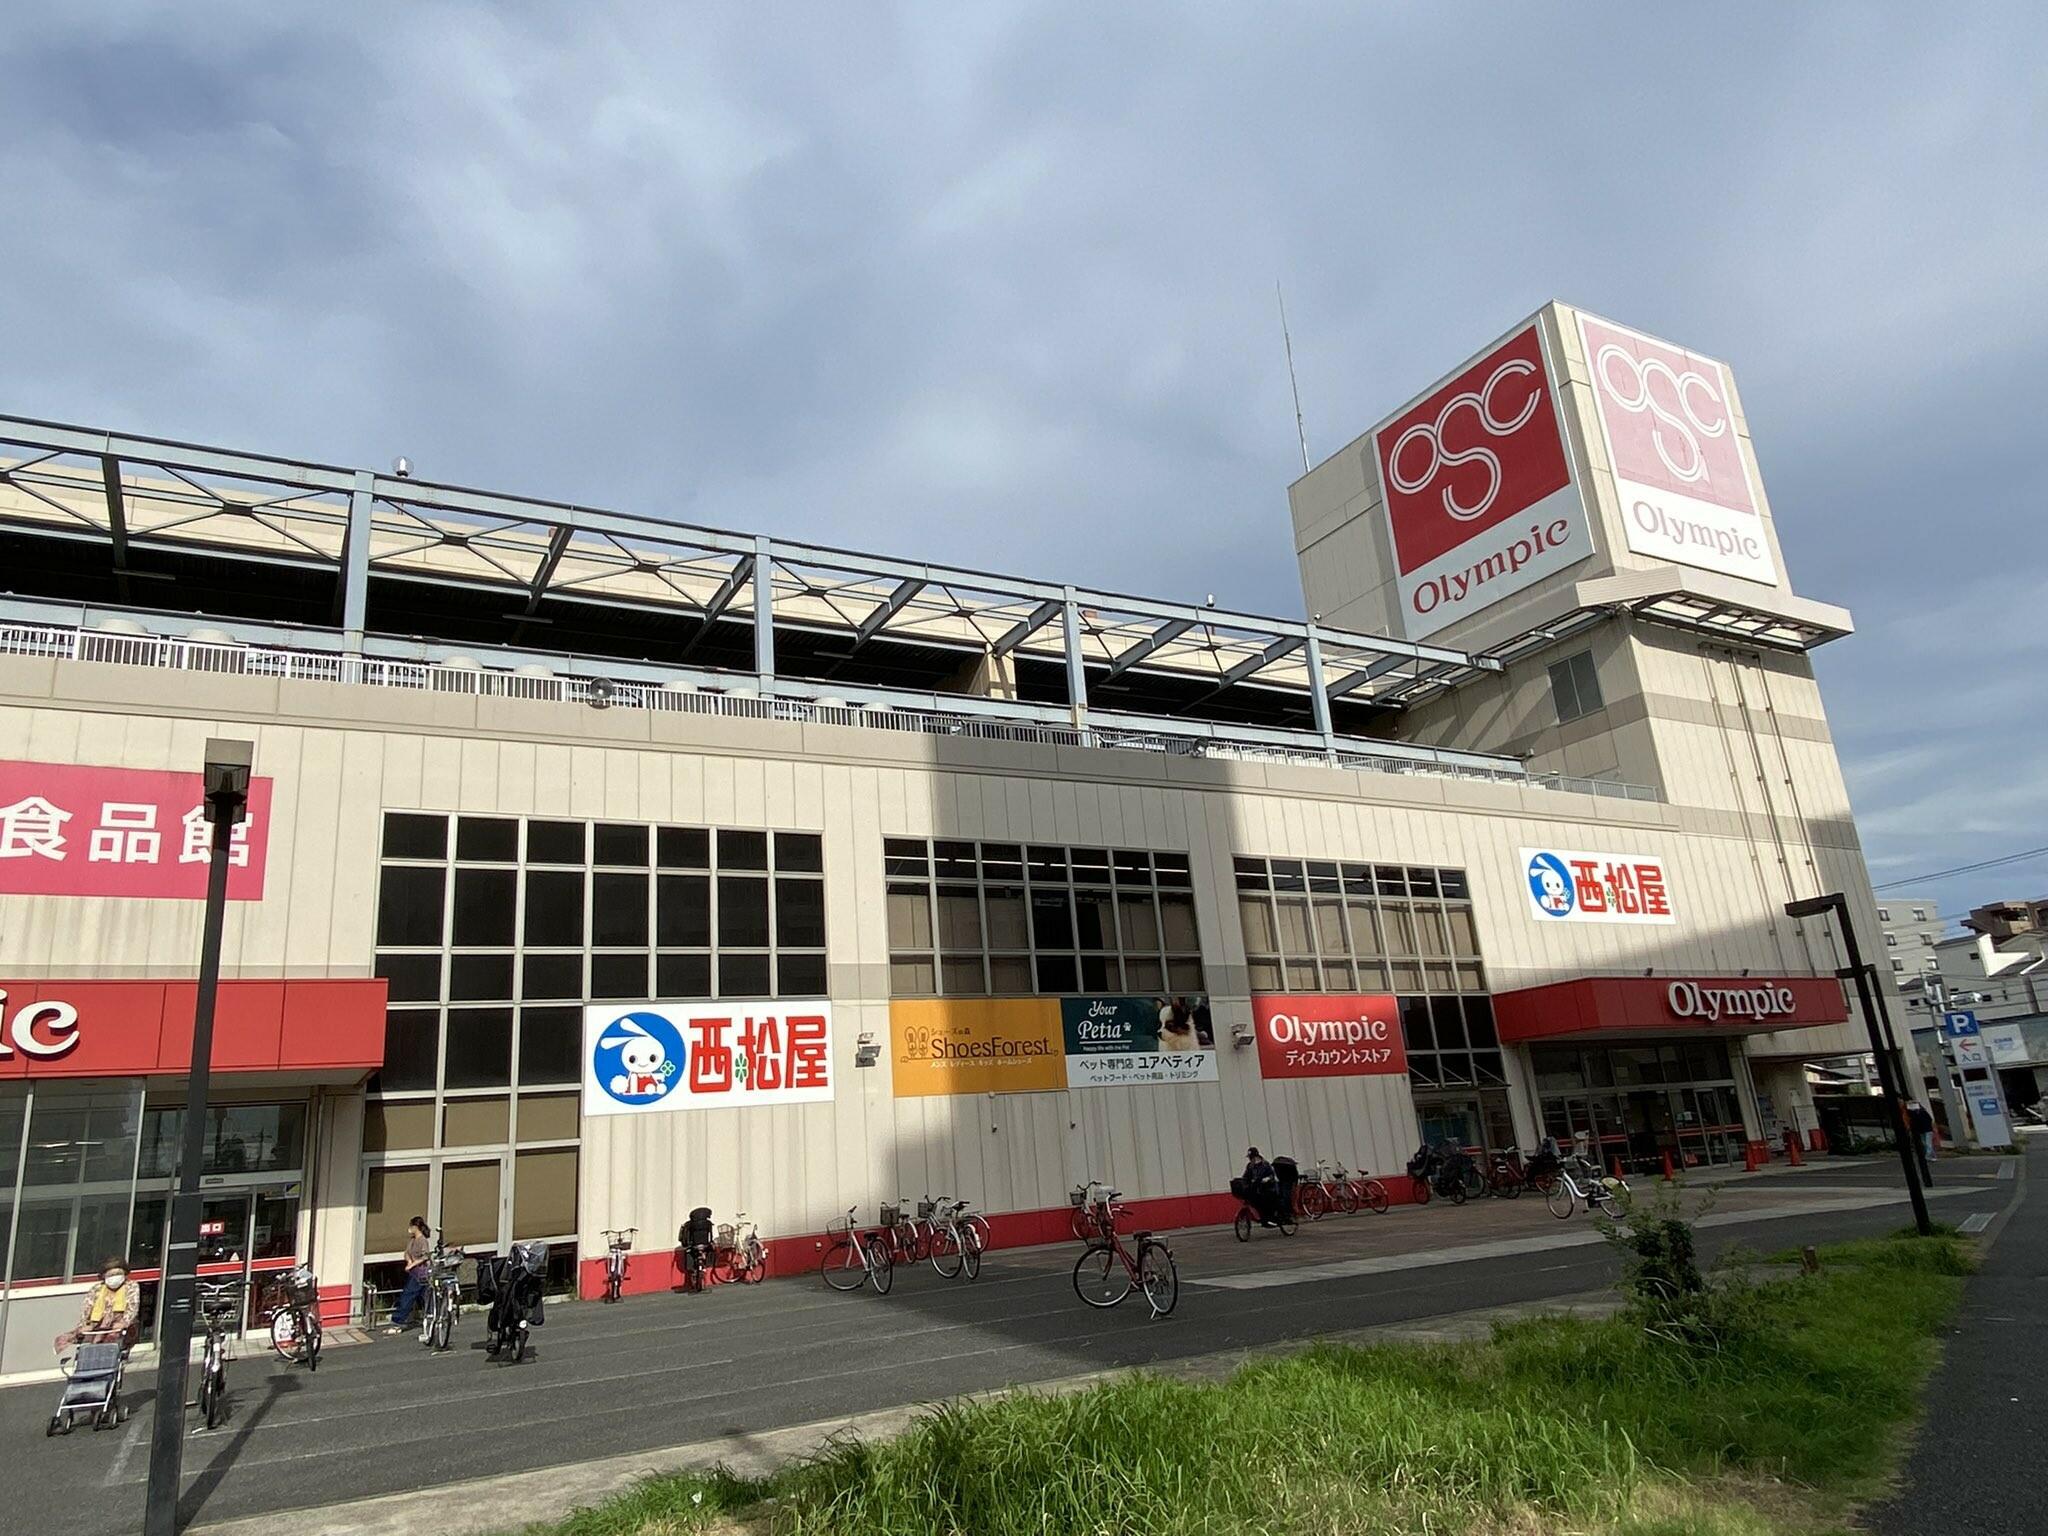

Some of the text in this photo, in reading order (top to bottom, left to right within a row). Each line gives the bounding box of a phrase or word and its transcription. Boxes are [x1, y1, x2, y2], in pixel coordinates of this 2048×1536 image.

[1597, 343, 1725, 483] OSC
[1389, 359, 1541, 521] OSC
[1633, 500, 1762, 561] Olympic
[1412, 518, 1570, 615] Olympic
[1569, 860, 1671, 915] 西松屋
[1088, 1000, 1118, 1017] Your
[1668, 981, 1797, 1021] Olympic
[1077, 1019, 1122, 1040] Petia
[1269, 1014, 1388, 1046] Olympic
[1951, 1014, 1970, 1033] P
[689, 1015, 828, 1093] 西松屋
[931, 1036, 1050, 1058] ShoesForest
[1079, 1055, 1205, 1071] ペット専門店 ユアペティア
[1286, 1049, 1391, 1066] ディスカウントストア
[1961, 1052, 1982, 1062] 入口
